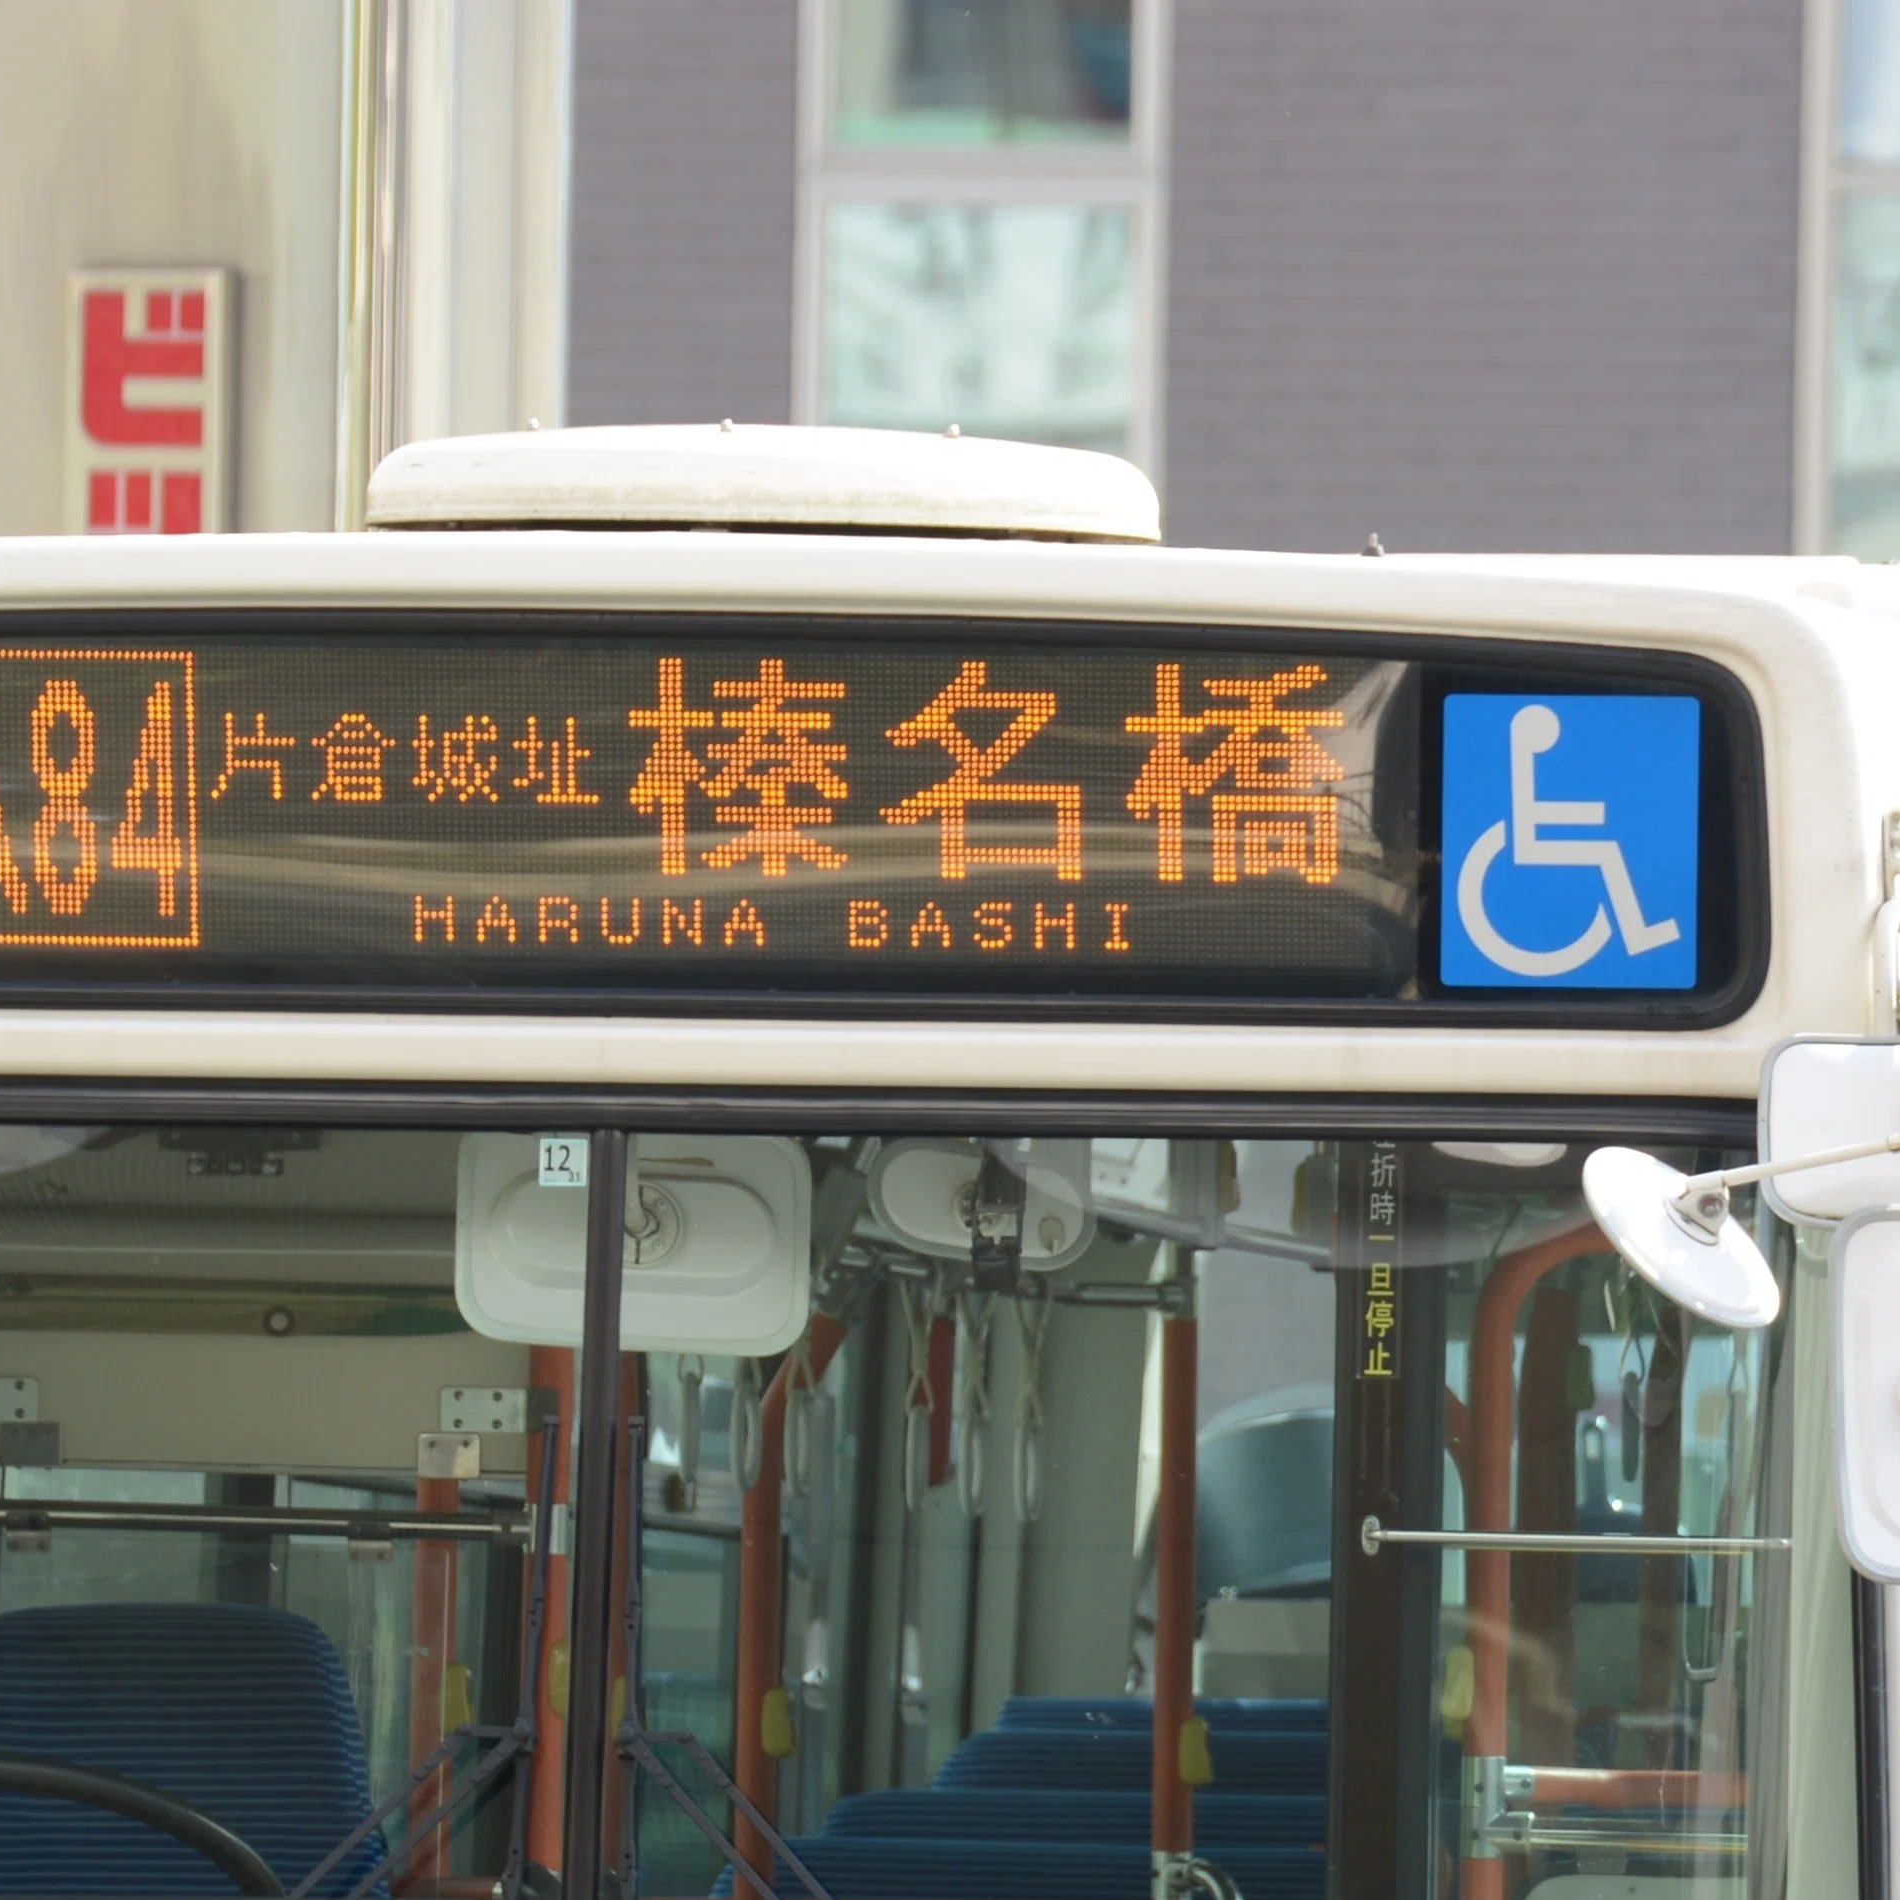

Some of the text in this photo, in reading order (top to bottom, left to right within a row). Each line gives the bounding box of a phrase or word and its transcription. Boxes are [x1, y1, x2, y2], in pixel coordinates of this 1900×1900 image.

[209, 711, 601, 803] 片倉城址
[628, 656, 1347, 886] 榛名橋
[413, 894, 1132, 952] HARUNA BASHI
[543, 1143, 571, 1172] 12
